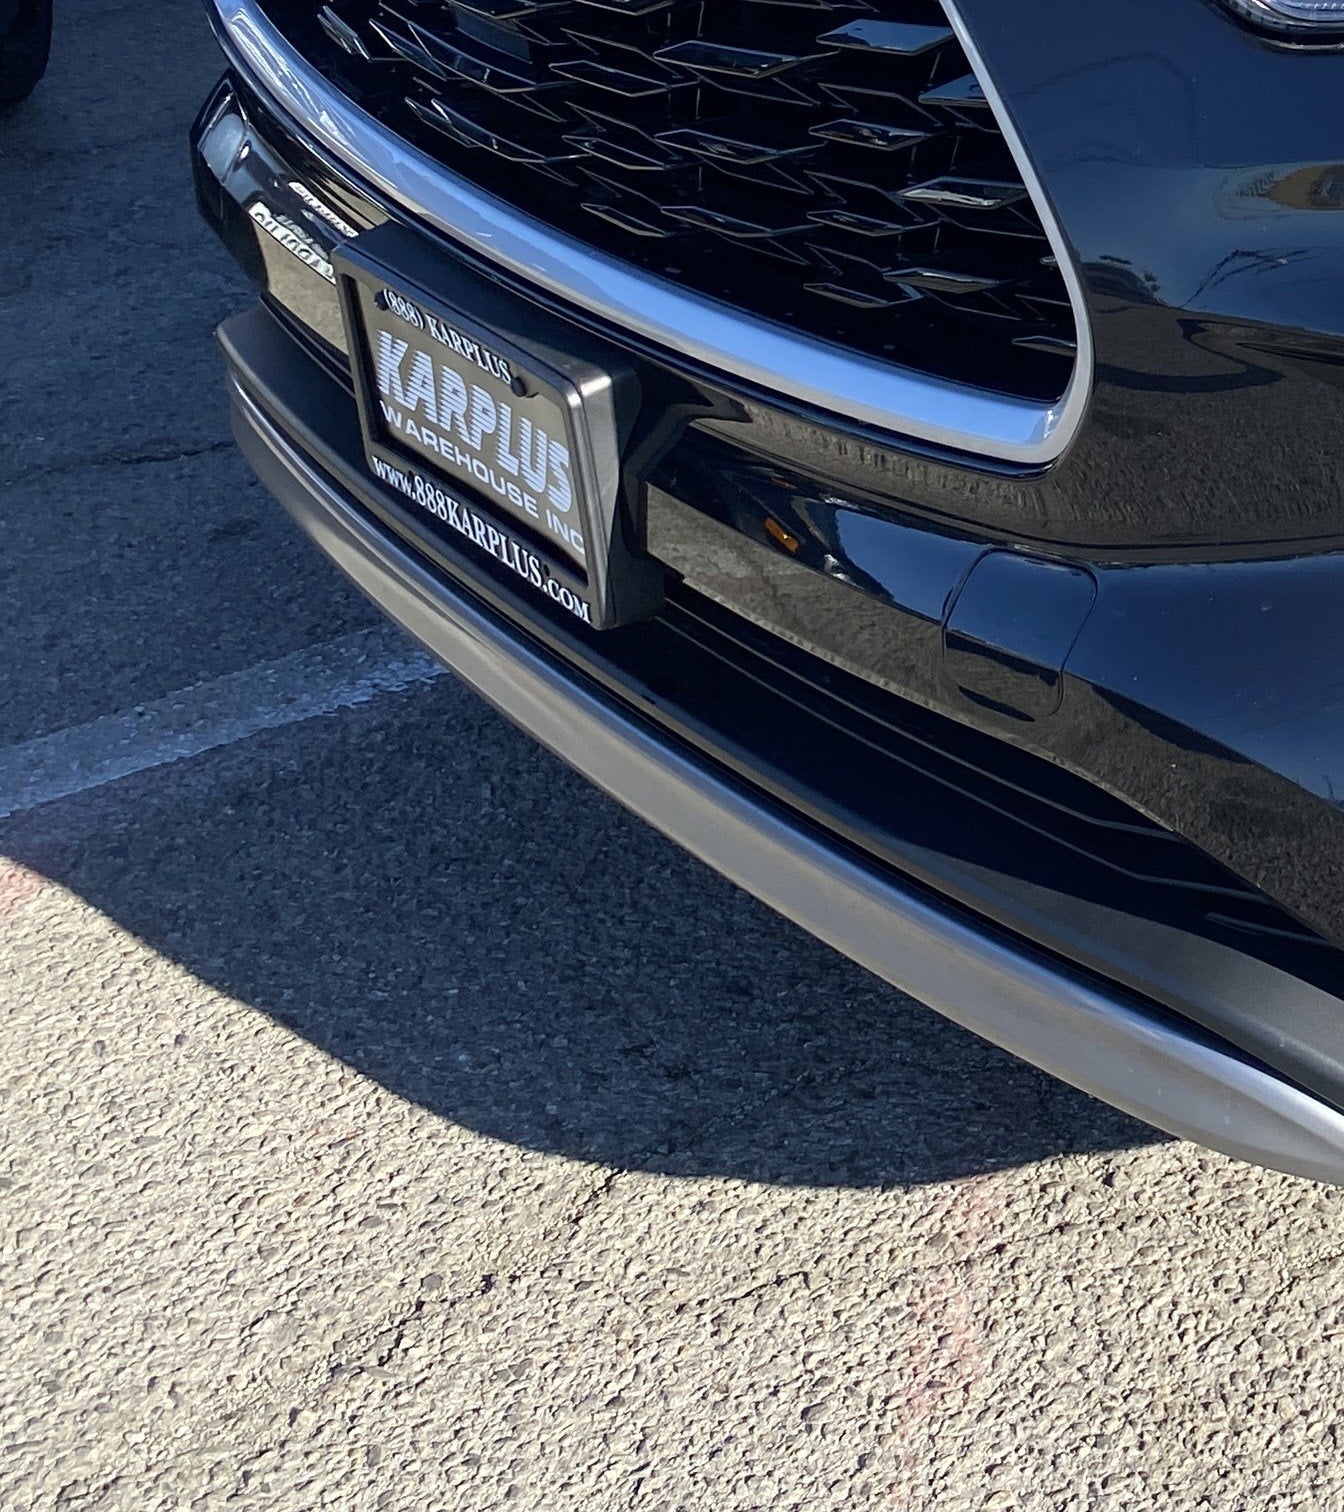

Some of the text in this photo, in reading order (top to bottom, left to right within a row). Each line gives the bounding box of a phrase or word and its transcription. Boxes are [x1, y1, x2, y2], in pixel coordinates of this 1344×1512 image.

[383, 288, 512, 385] (888) KARPLUS
[377, 329, 573, 513] KARPLUS
[379, 400, 539, 519] WAREHOUSE
